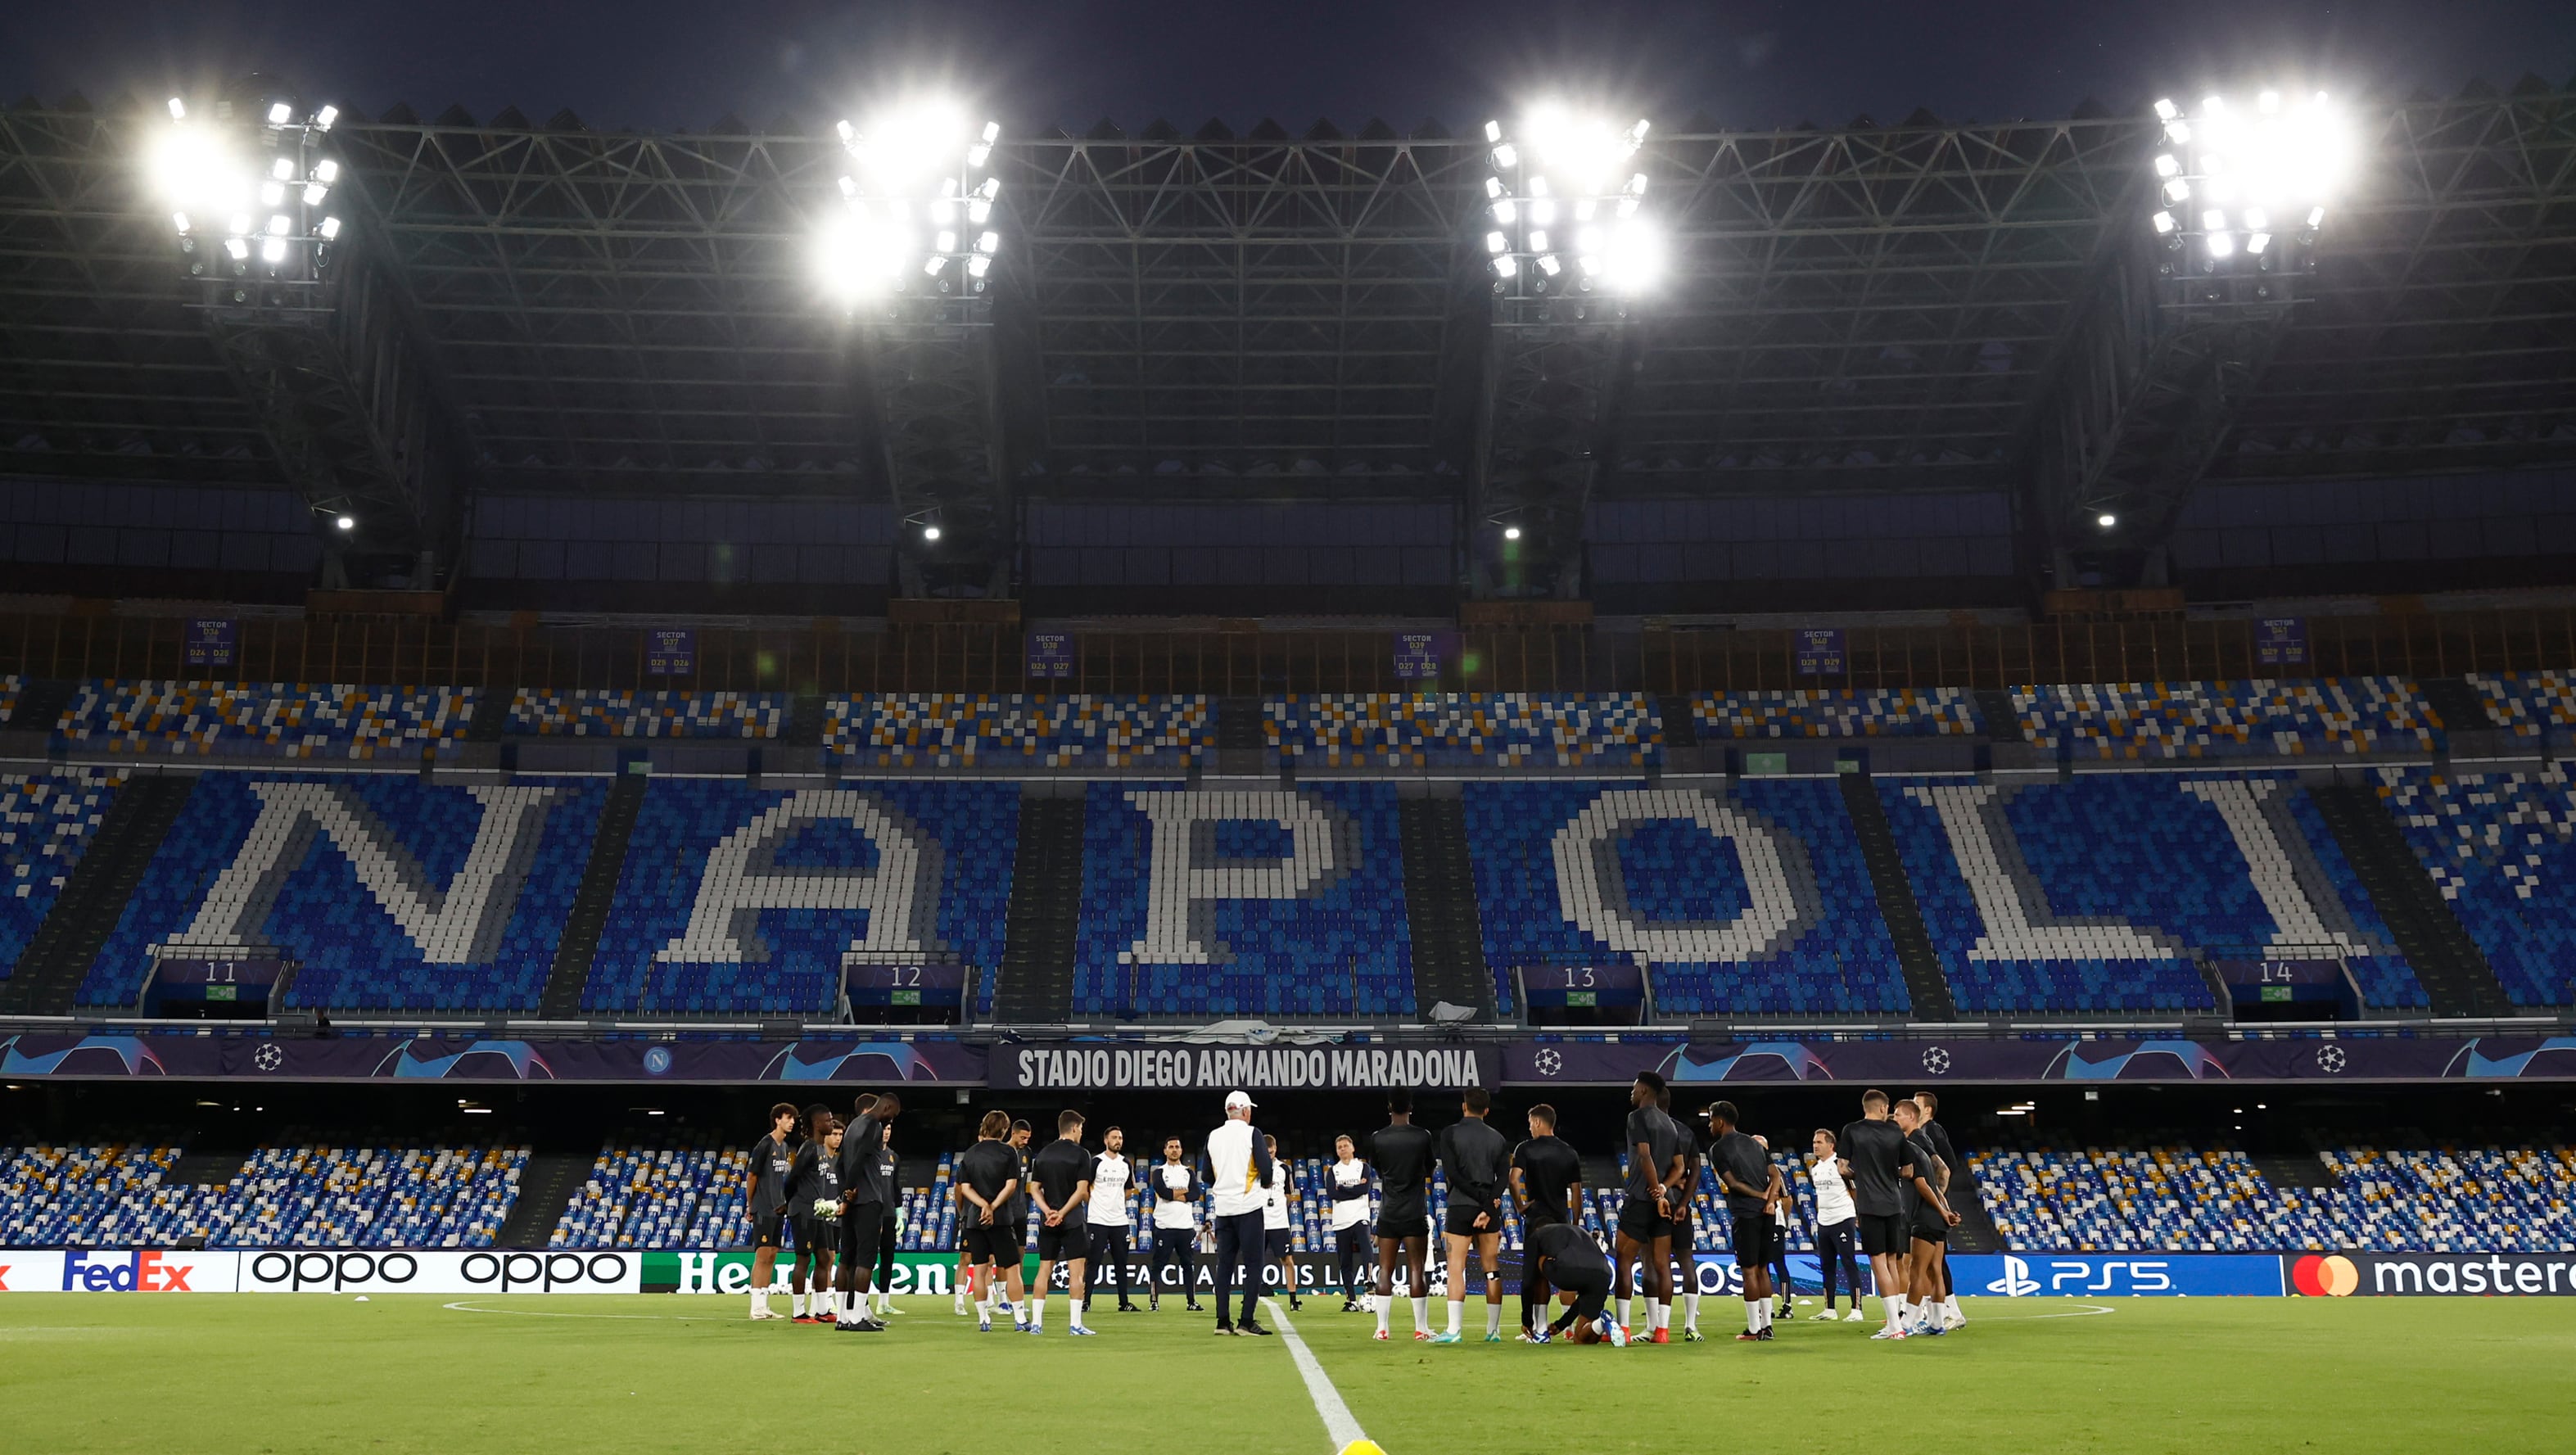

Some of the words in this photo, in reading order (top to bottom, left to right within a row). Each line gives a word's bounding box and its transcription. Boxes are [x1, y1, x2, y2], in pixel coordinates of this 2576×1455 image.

[146, 782, 2370, 965] NAPOLI
[206, 962, 235, 982] 11
[892, 967, 920, 987] 12
[1566, 968, 1595, 987] 13
[2260, 962, 2293, 982] 14
[1018, 1049, 1109, 1087] STADIO
[1114, 1049, 1191, 1087] DIEGO
[1196, 1049, 1323, 1087] ARMANDO
[1331, 1049, 1480, 1087] MARADONA
[62, 1250, 194, 1291] FedEx
[252, 1252, 418, 1292] oppo
[461, 1253, 627, 1293] oppo
[676, 1252, 951, 1295] Henen
[1160, 1264, 1314, 1286] CHAPONS
[1325, 1265, 1408, 1286] LAU
[2051, 1262, 2170, 1290] PS5
